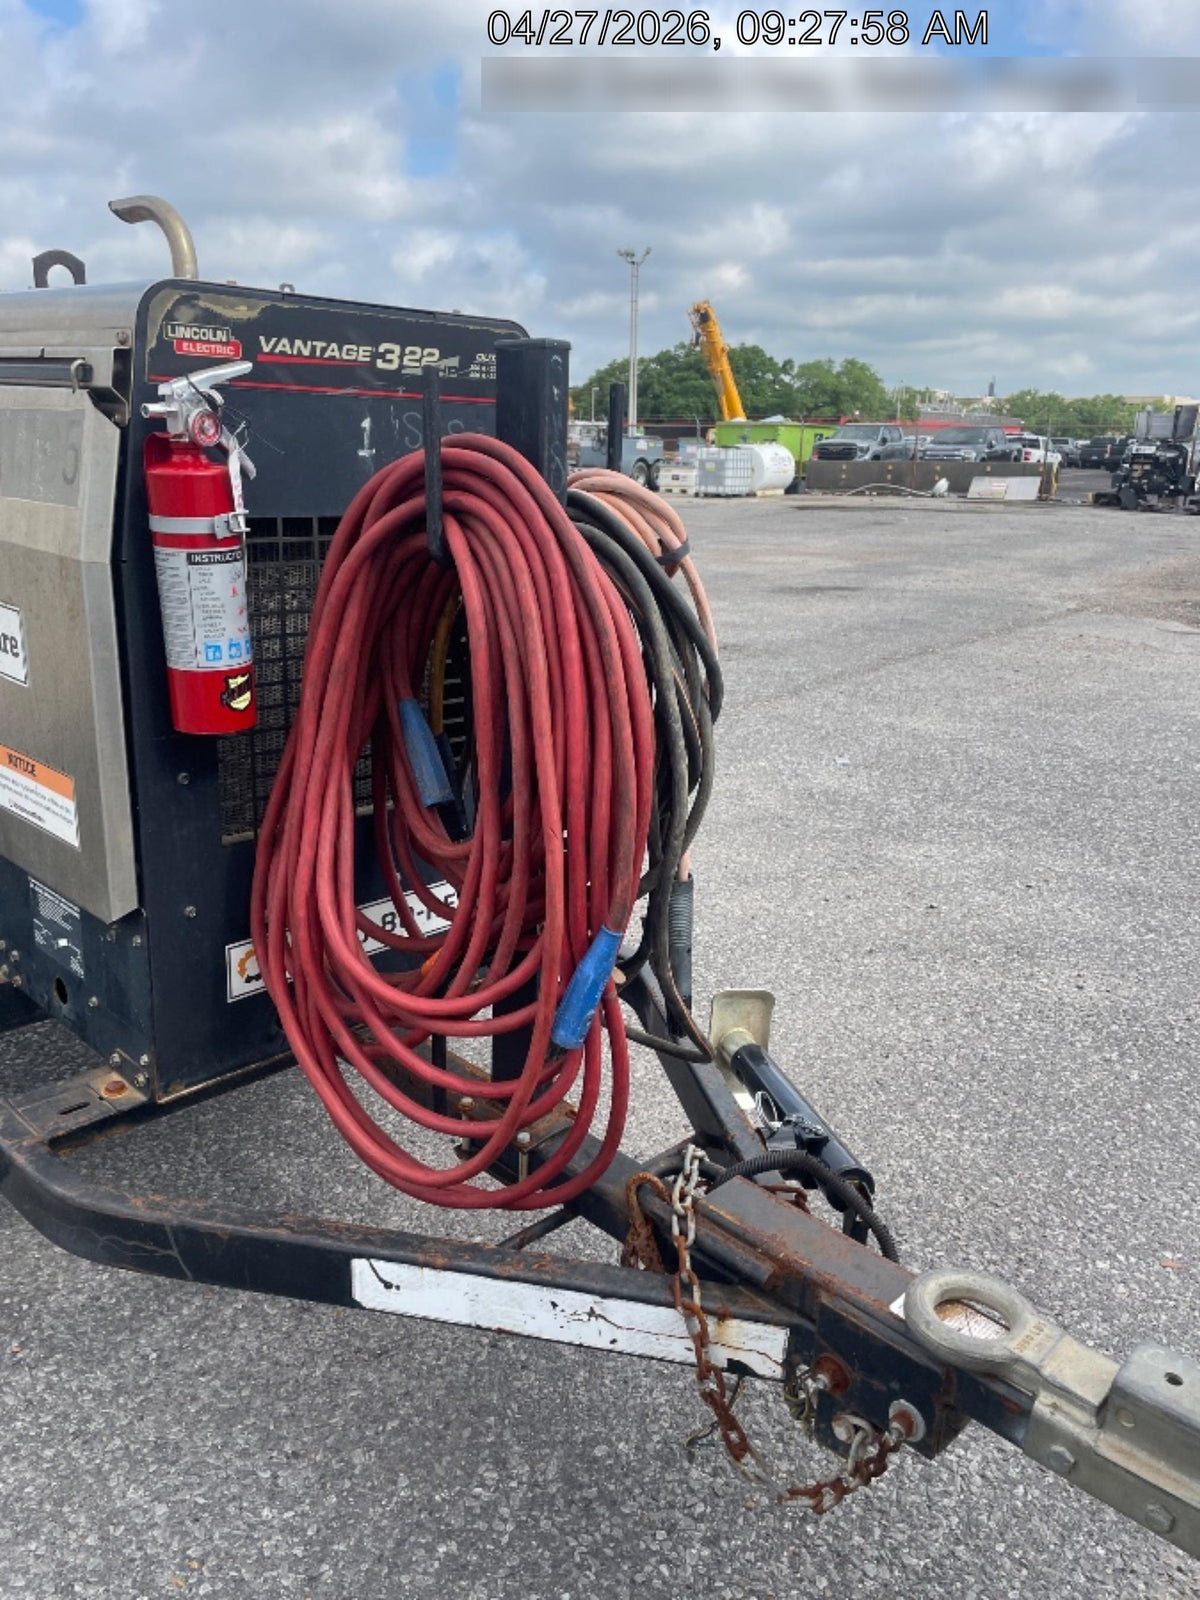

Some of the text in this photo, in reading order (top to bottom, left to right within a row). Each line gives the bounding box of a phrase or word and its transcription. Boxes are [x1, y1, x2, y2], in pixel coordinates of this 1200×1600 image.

[167, 324, 227, 342] LINCOLN
[182, 342, 235, 355] ELECTRIC
[258, 335, 440, 371] VANTAGE 322
